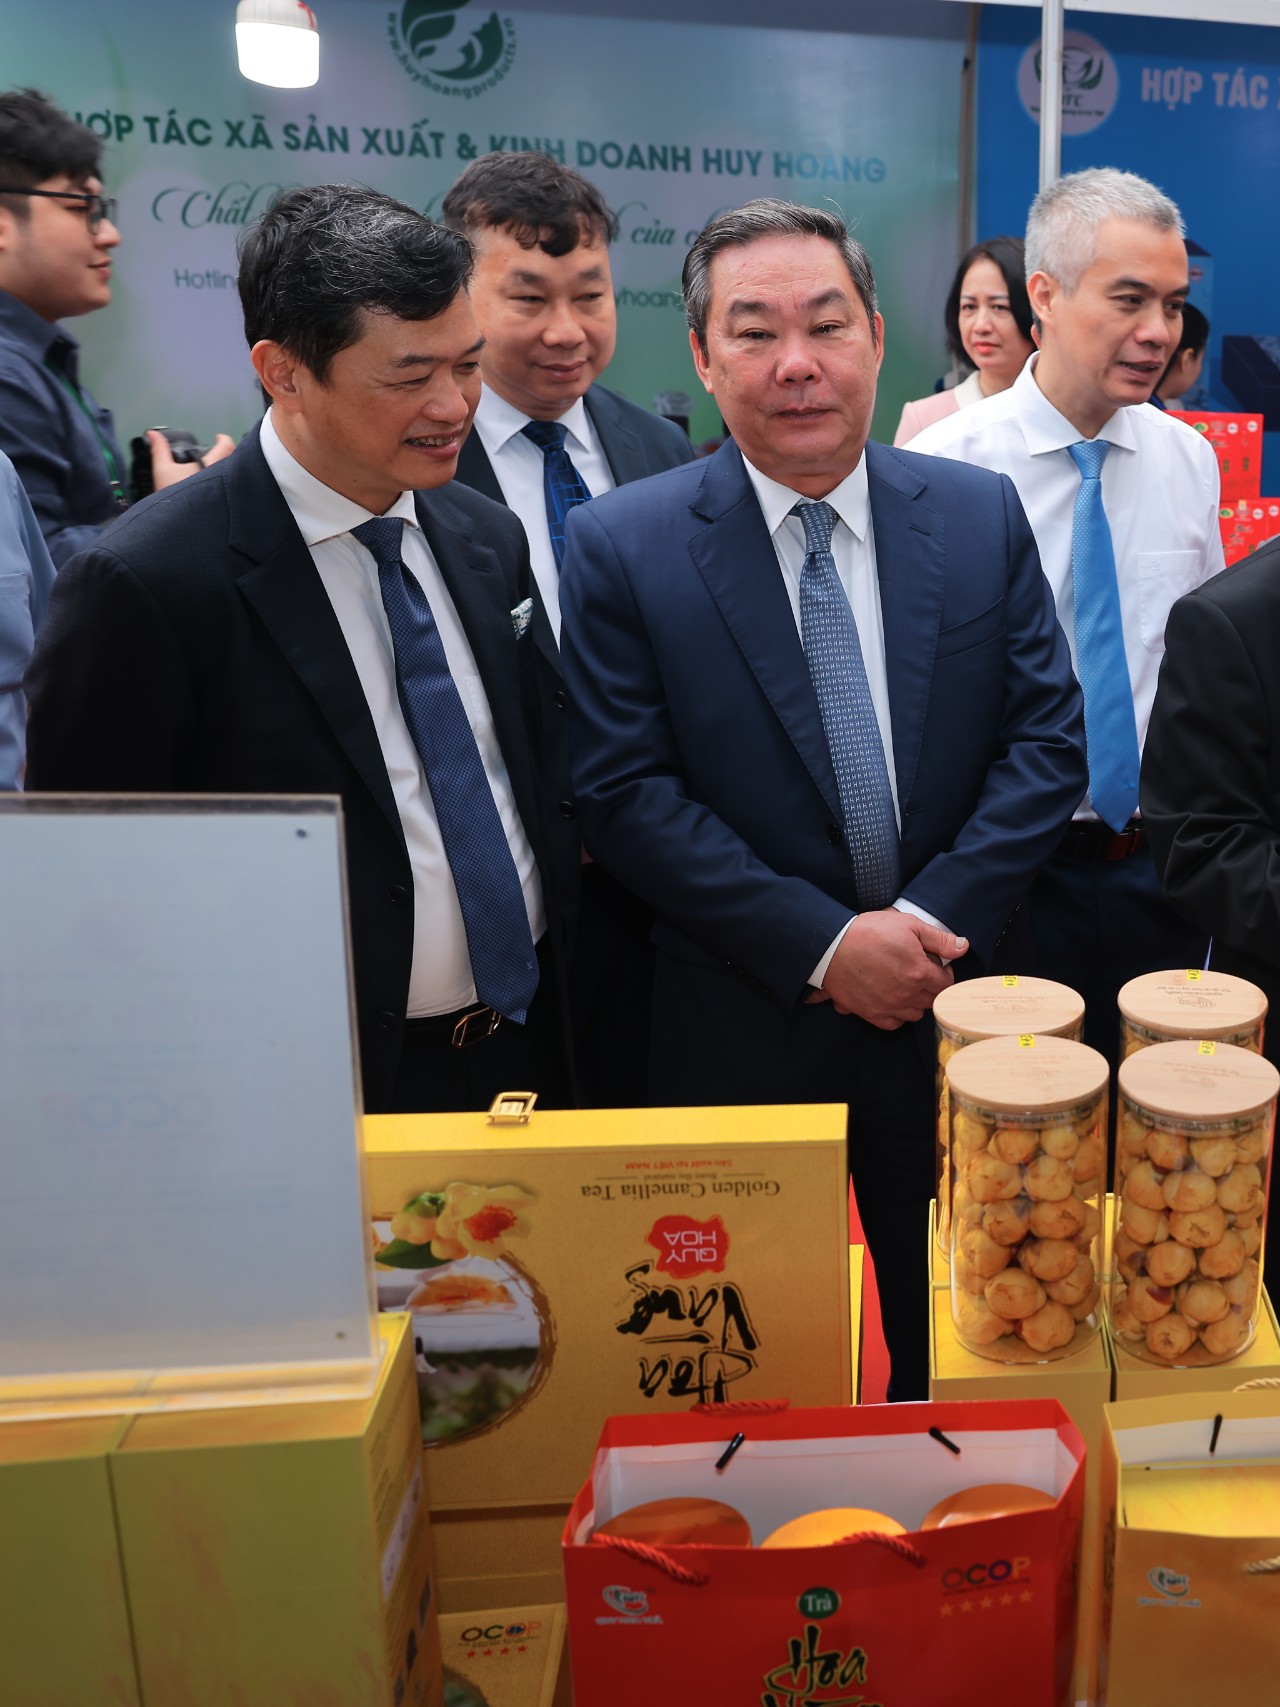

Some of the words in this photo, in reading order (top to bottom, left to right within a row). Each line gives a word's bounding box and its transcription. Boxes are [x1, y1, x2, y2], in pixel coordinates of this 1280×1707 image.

[1141, 67, 1202, 110] HỢP
[1212, 67, 1267, 109] TÁC
[144, 109, 212, 147] TÁC
[225, 115, 273, 150] XÃ
[283, 117, 349, 154] SẢN
[361, 118, 445, 159] XUẤT
[456, 132, 478, 160] &
[576, 140, 692, 173] DOANH
[703, 148, 763, 177] HUY
[773, 145, 887, 184] HOÀNG
[173, 267, 240, 290] Hotlin
[580, 1184, 616, 1201] Tea
[620, 1181, 706, 1200] Camellia
[712, 1180, 781, 1197] Golden
[663, 1230, 717, 1244] HOA
[665, 1247, 717, 1264] QUY
[942, 1557, 1032, 1589] OCOP
[803, 1592, 833, 1613] Trà
[460, 1621, 543, 1642] OCOP
[764, 1623, 869, 1697] Hoa
